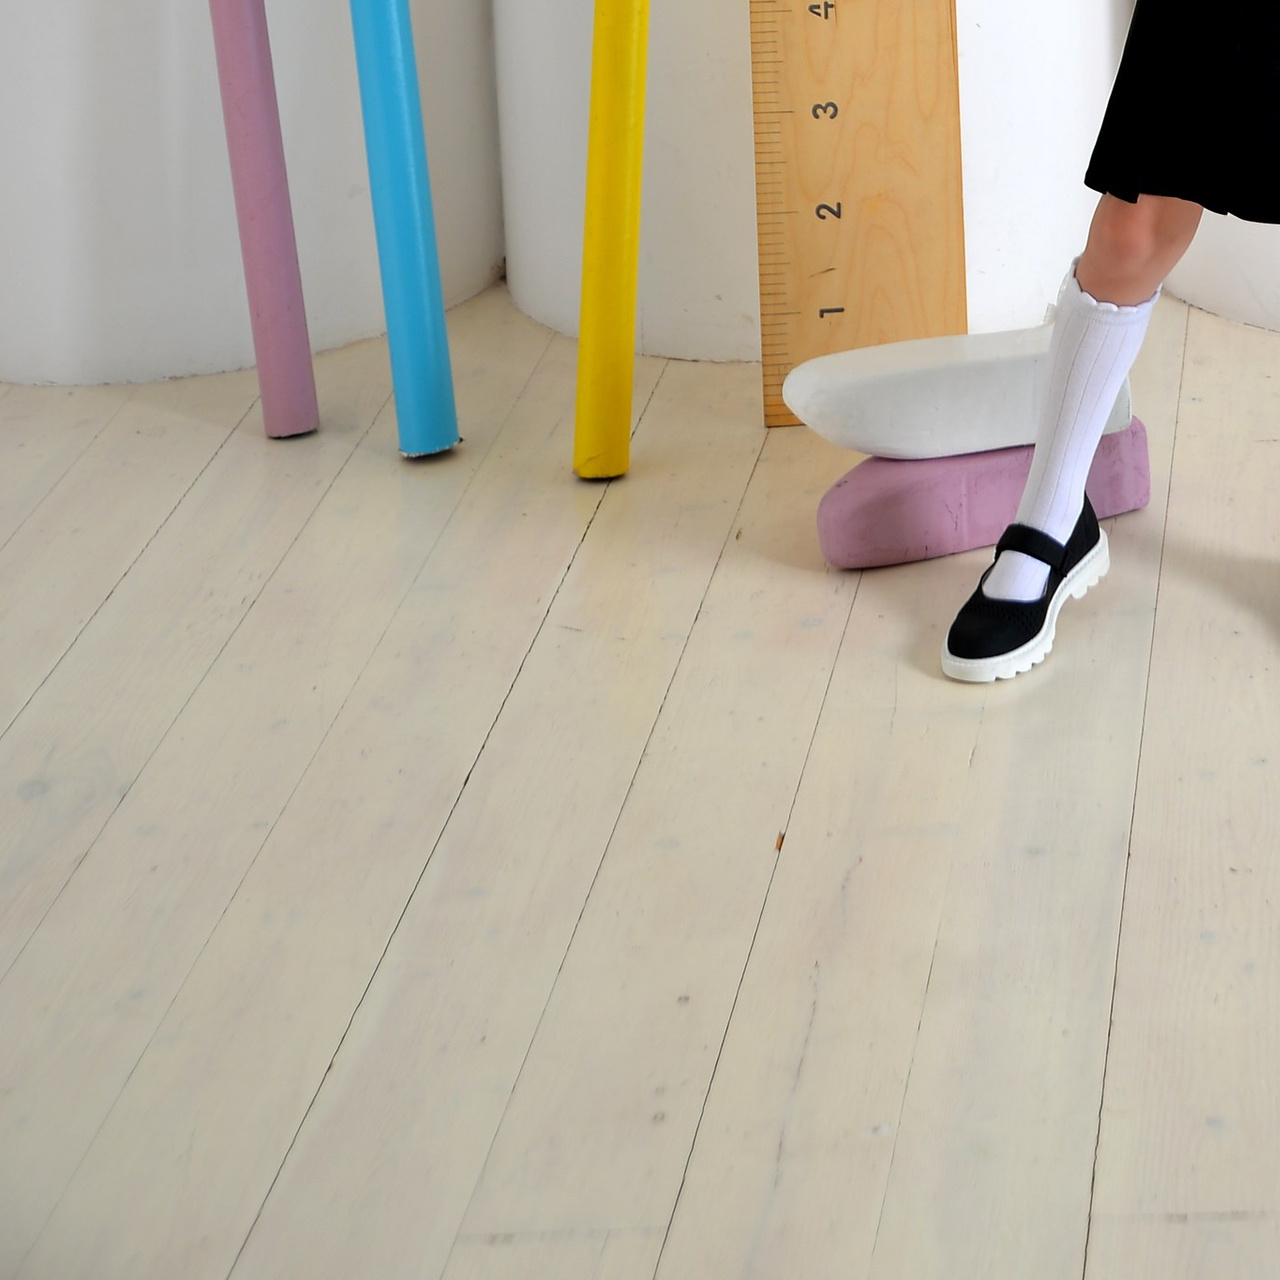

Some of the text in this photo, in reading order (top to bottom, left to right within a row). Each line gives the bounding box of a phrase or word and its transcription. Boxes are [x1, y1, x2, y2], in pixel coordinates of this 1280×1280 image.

[808, 1, 834, 20] 4
[812, 101, 838, 119] 3
[815, 202, 841, 220] 2
[819, 307, 844, 318] 1
